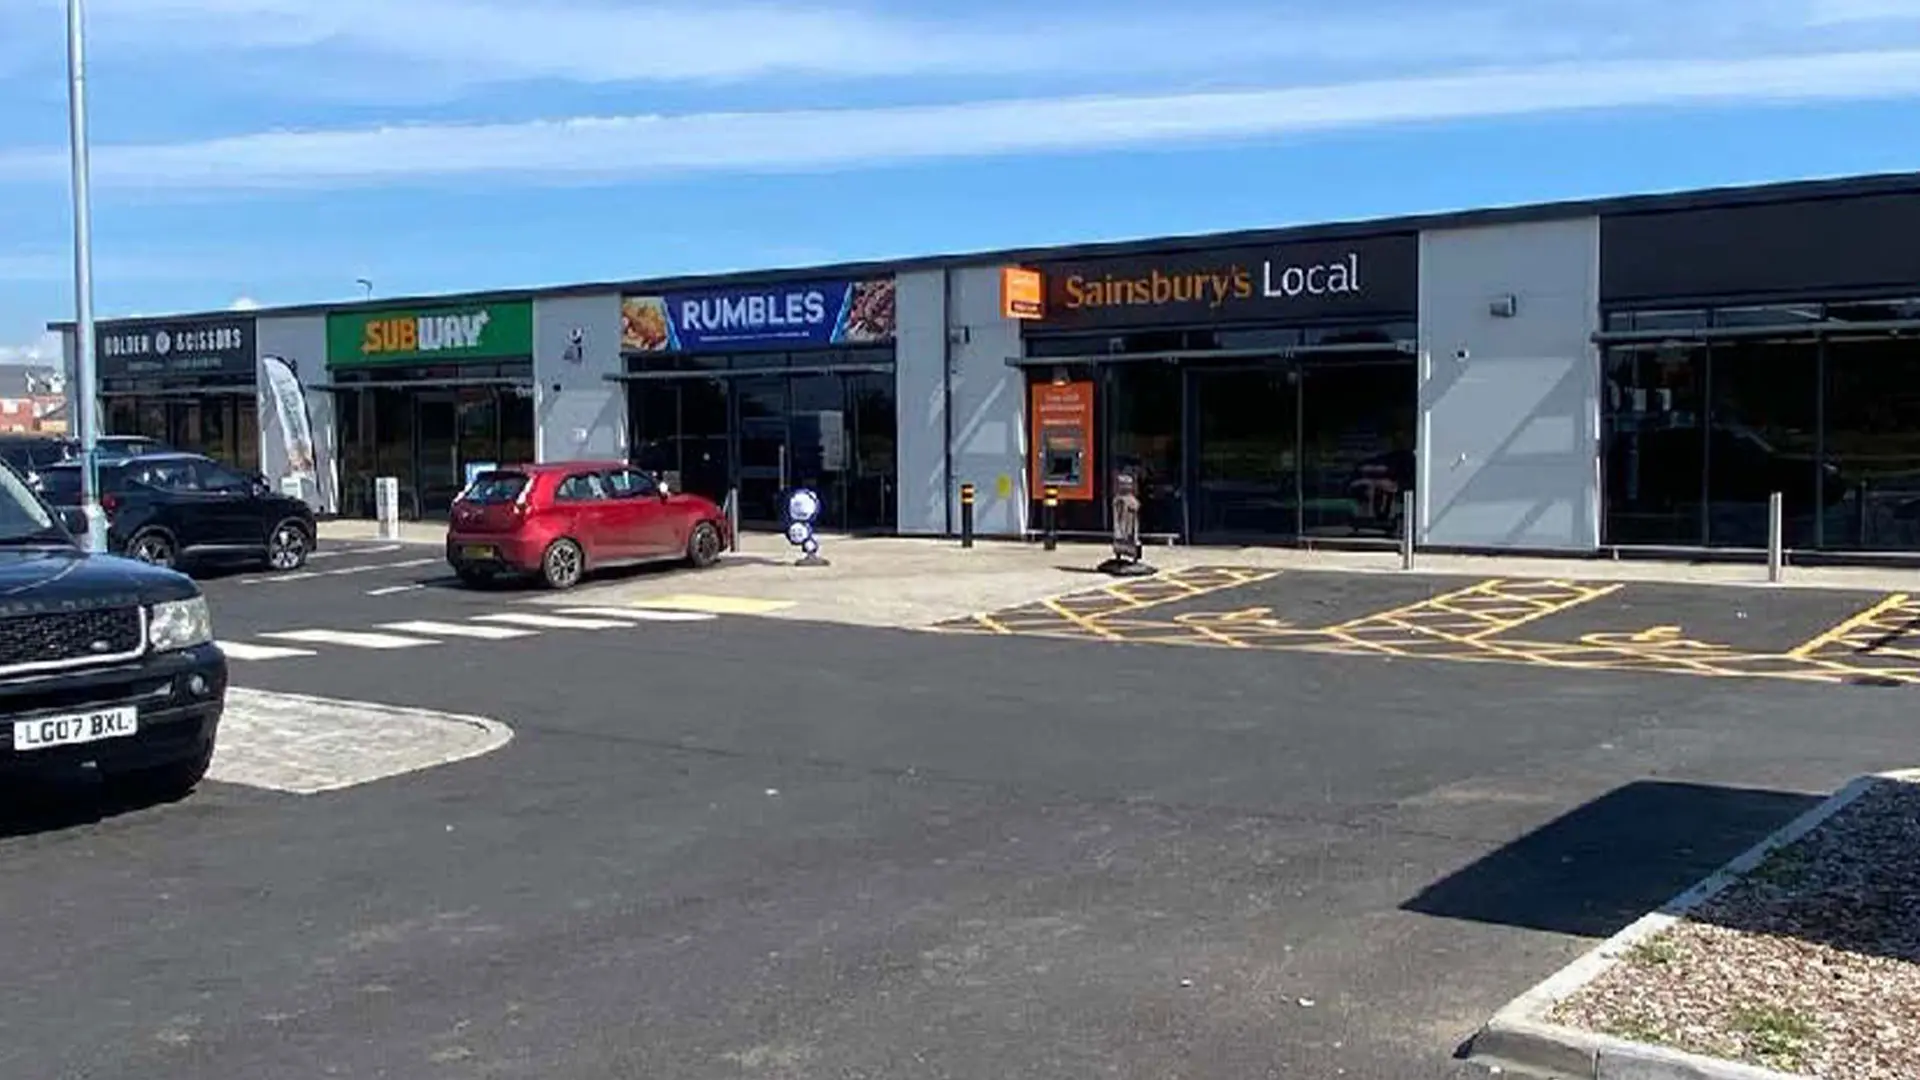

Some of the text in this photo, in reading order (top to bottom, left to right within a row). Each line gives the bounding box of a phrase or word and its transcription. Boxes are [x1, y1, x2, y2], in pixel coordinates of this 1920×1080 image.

[1065, 264, 1253, 308] Sainsbury's
[1262, 253, 1359, 298] Local
[682, 291, 825, 330] RUMBLES
[361, 311, 489, 354] SUBWAY
[25, 712, 129, 744] LG07 BXL
